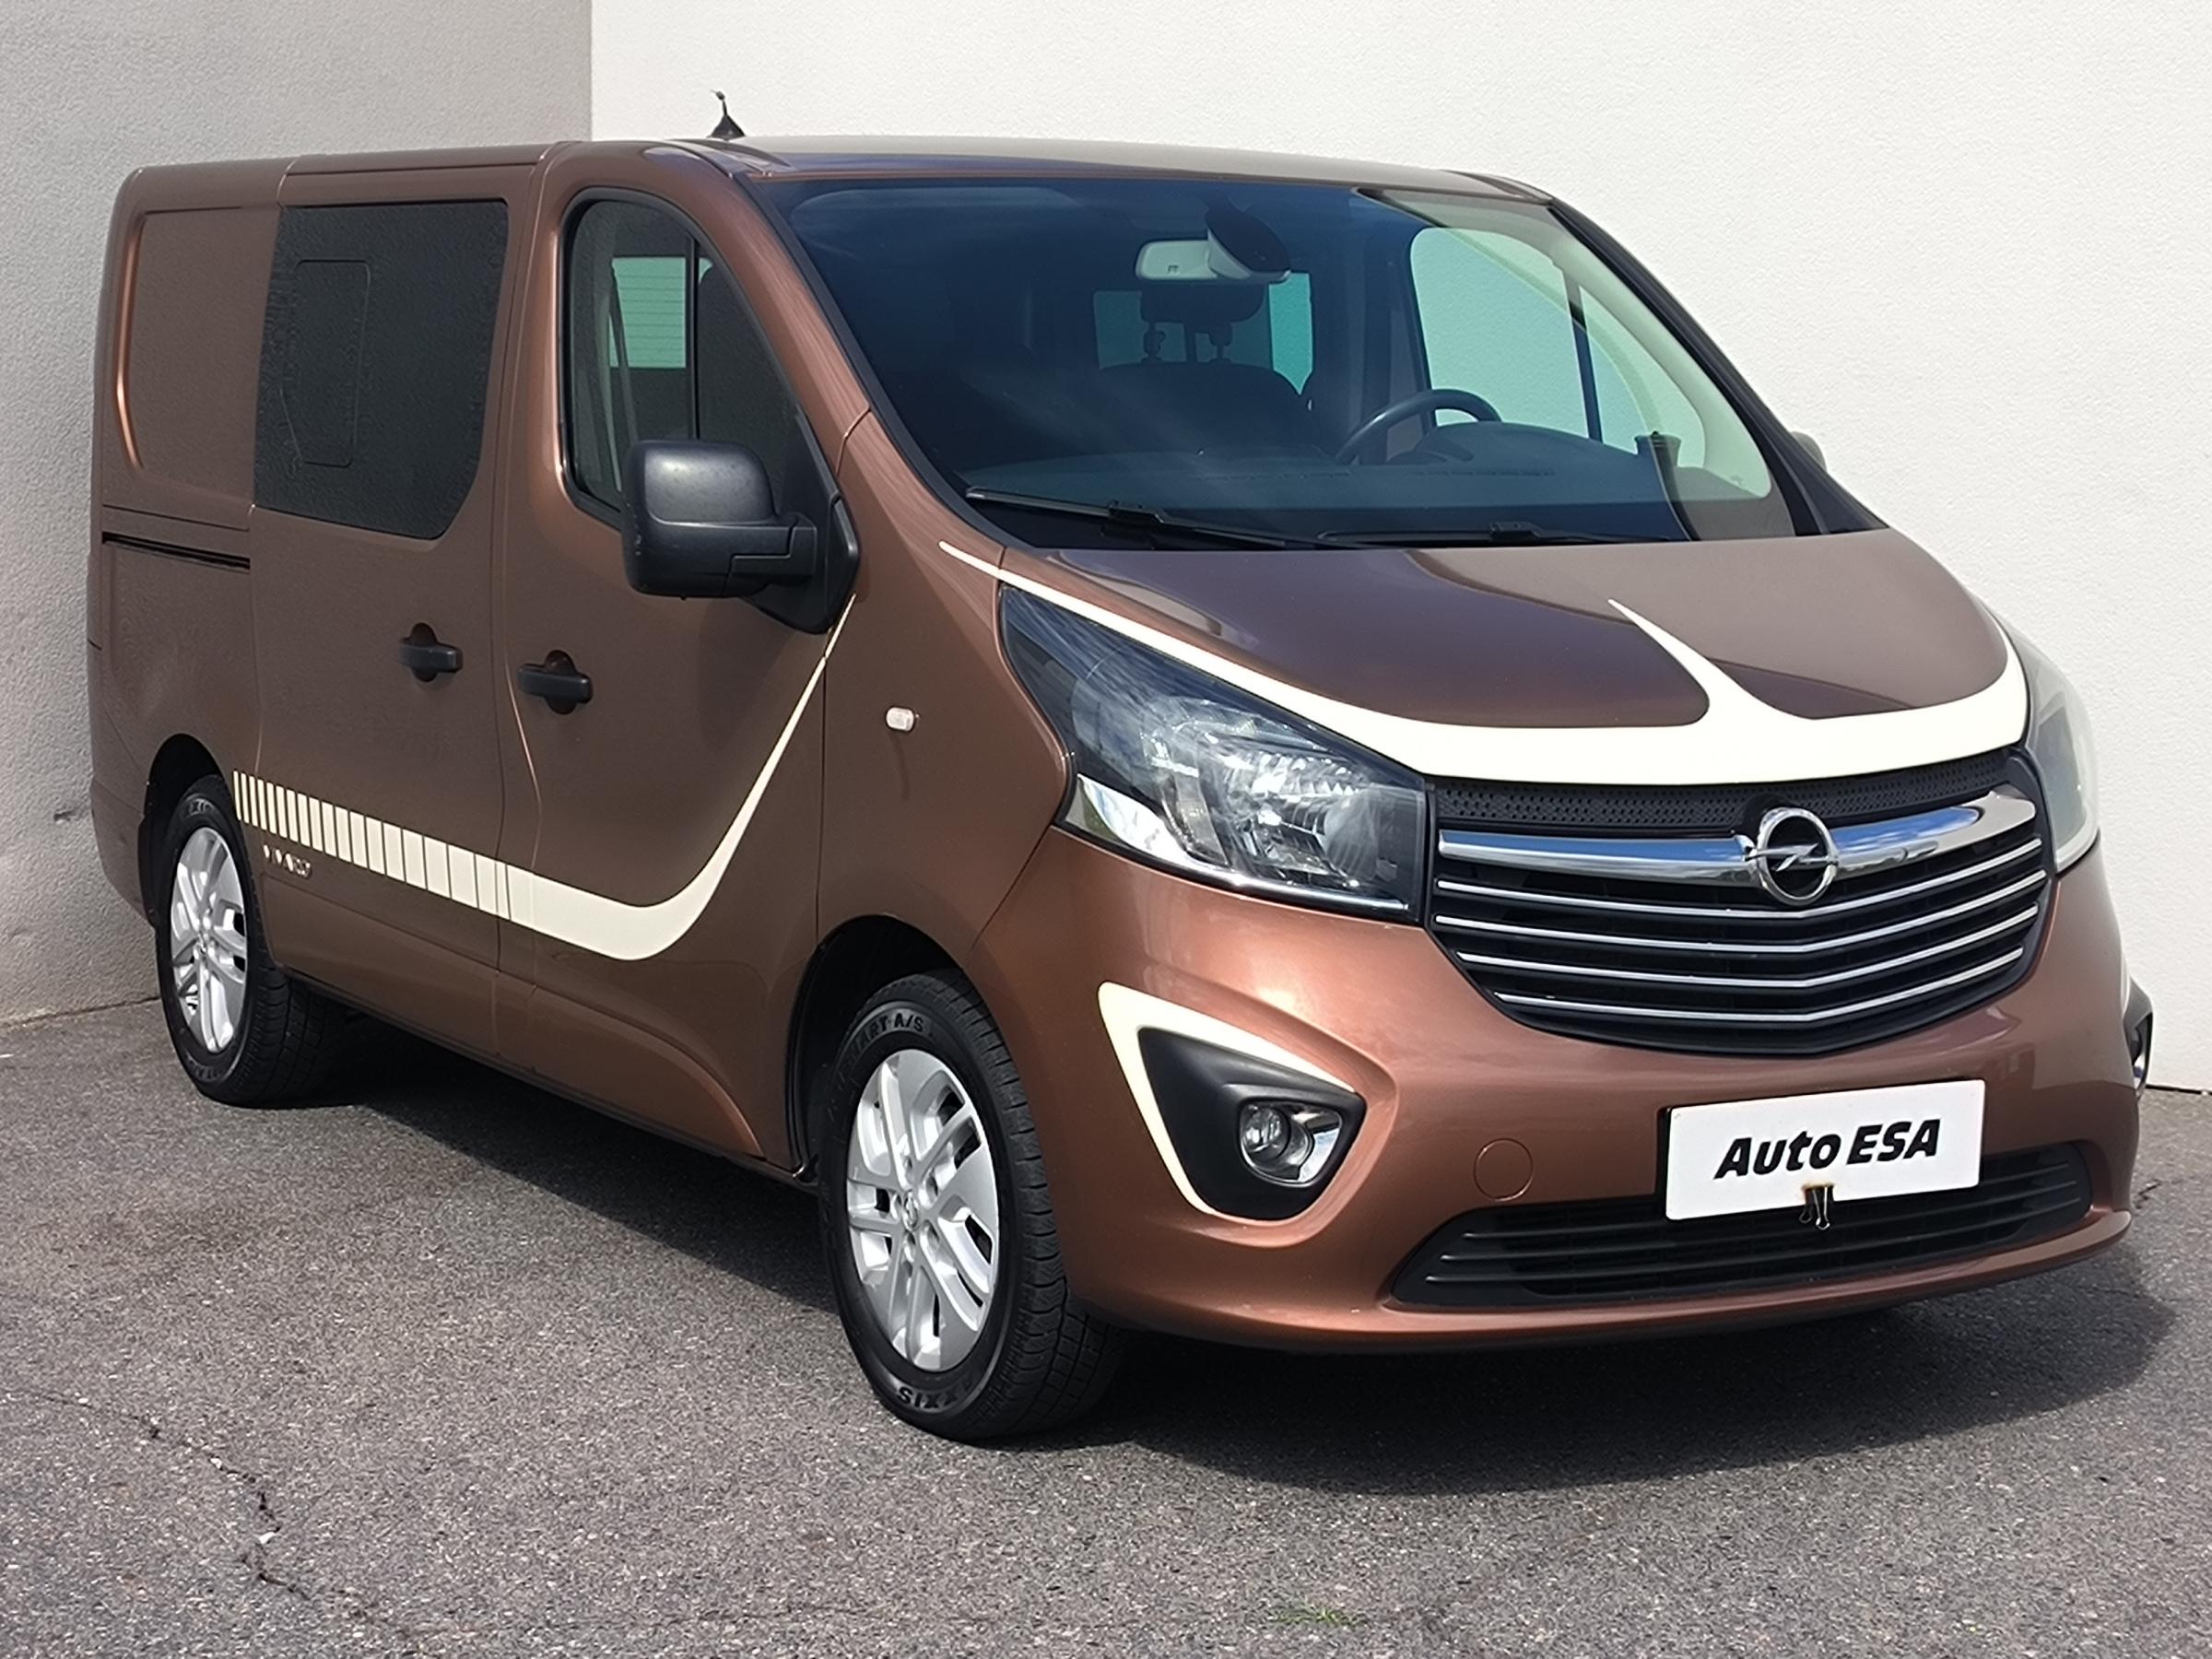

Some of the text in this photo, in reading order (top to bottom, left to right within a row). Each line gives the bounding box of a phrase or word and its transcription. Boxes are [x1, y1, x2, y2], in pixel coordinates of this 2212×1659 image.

[894, 1013, 924, 1032] A/S
[1713, 1119, 1941, 1180] Auto ESA
